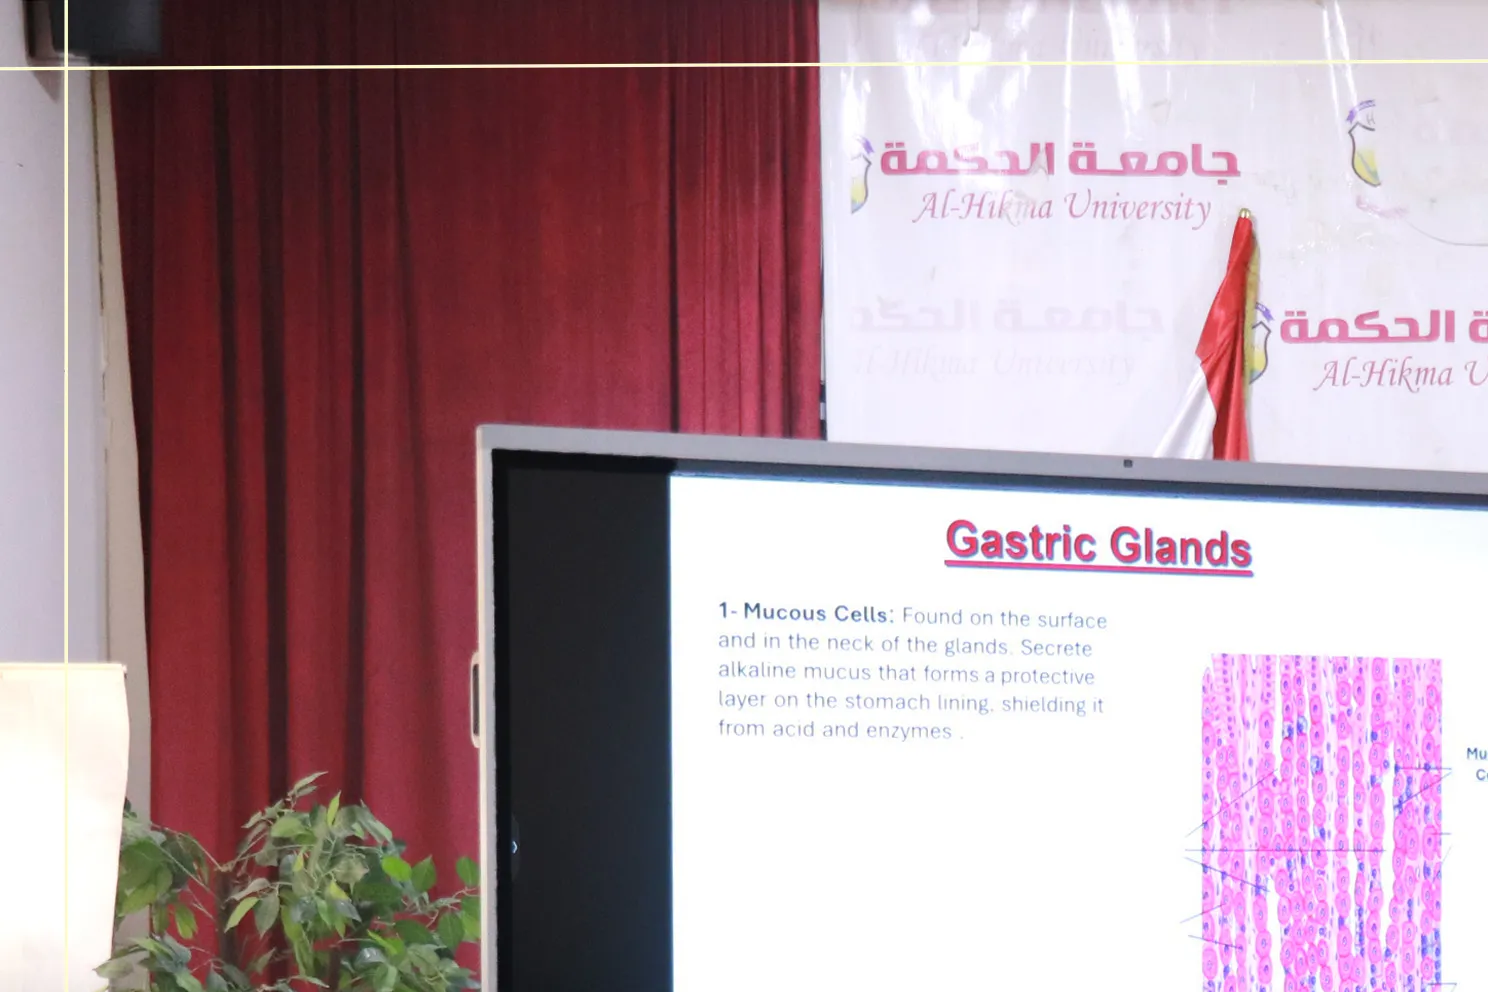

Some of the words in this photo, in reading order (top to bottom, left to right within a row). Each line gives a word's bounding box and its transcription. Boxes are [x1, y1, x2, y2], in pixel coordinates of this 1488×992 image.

[880, 141, 1055, 175] الحكمة
[1068, 141, 1239, 184] جامعة
[911, 189, 1055, 225] Al-Hikma
[1063, 189, 1212, 231] University
[1280, 310, 1455, 343] الحكمة
[1311, 356, 1455, 393] Al-Hikma
[944, 519, 1096, 562] Gastric
[1108, 526, 1252, 568] Glands
[744, 602, 826, 621] Mucous
[834, 605, 893, 623] Cells:
[903, 607, 962, 625] Found
[970, 613, 993, 625] on
[1000, 611, 1030, 627] the
[1038, 612, 1107, 629] surface
[719, 632, 755, 648] and
[764, 636, 780, 648] in
[788, 633, 819, 650] the
[828, 635, 873, 651] neck
[881, 636, 899, 651] of
[907, 637, 938, 652] the
[1021, 638, 1092, 657] Secrete
[719, 661, 796, 678] alkaline
[804, 666, 871, 680] mucus
[879, 665, 915, 681] that
[924, 665, 979, 682] forms
[985, 670, 995, 683] a
[1001, 669, 1094, 686] protective
[719, 690, 766, 710] layer
[774, 695, 798, 707] on
[806, 692, 837, 708] the
[845, 694, 930, 710] stomach
[1002, 696, 1086, 717] shielding
[1093, 699, 1103, 713] it
[719, 719, 764, 736] from
[773, 721, 814, 737] acid
[823, 722, 858, 737] and
[866, 726, 952, 742] enzymes
